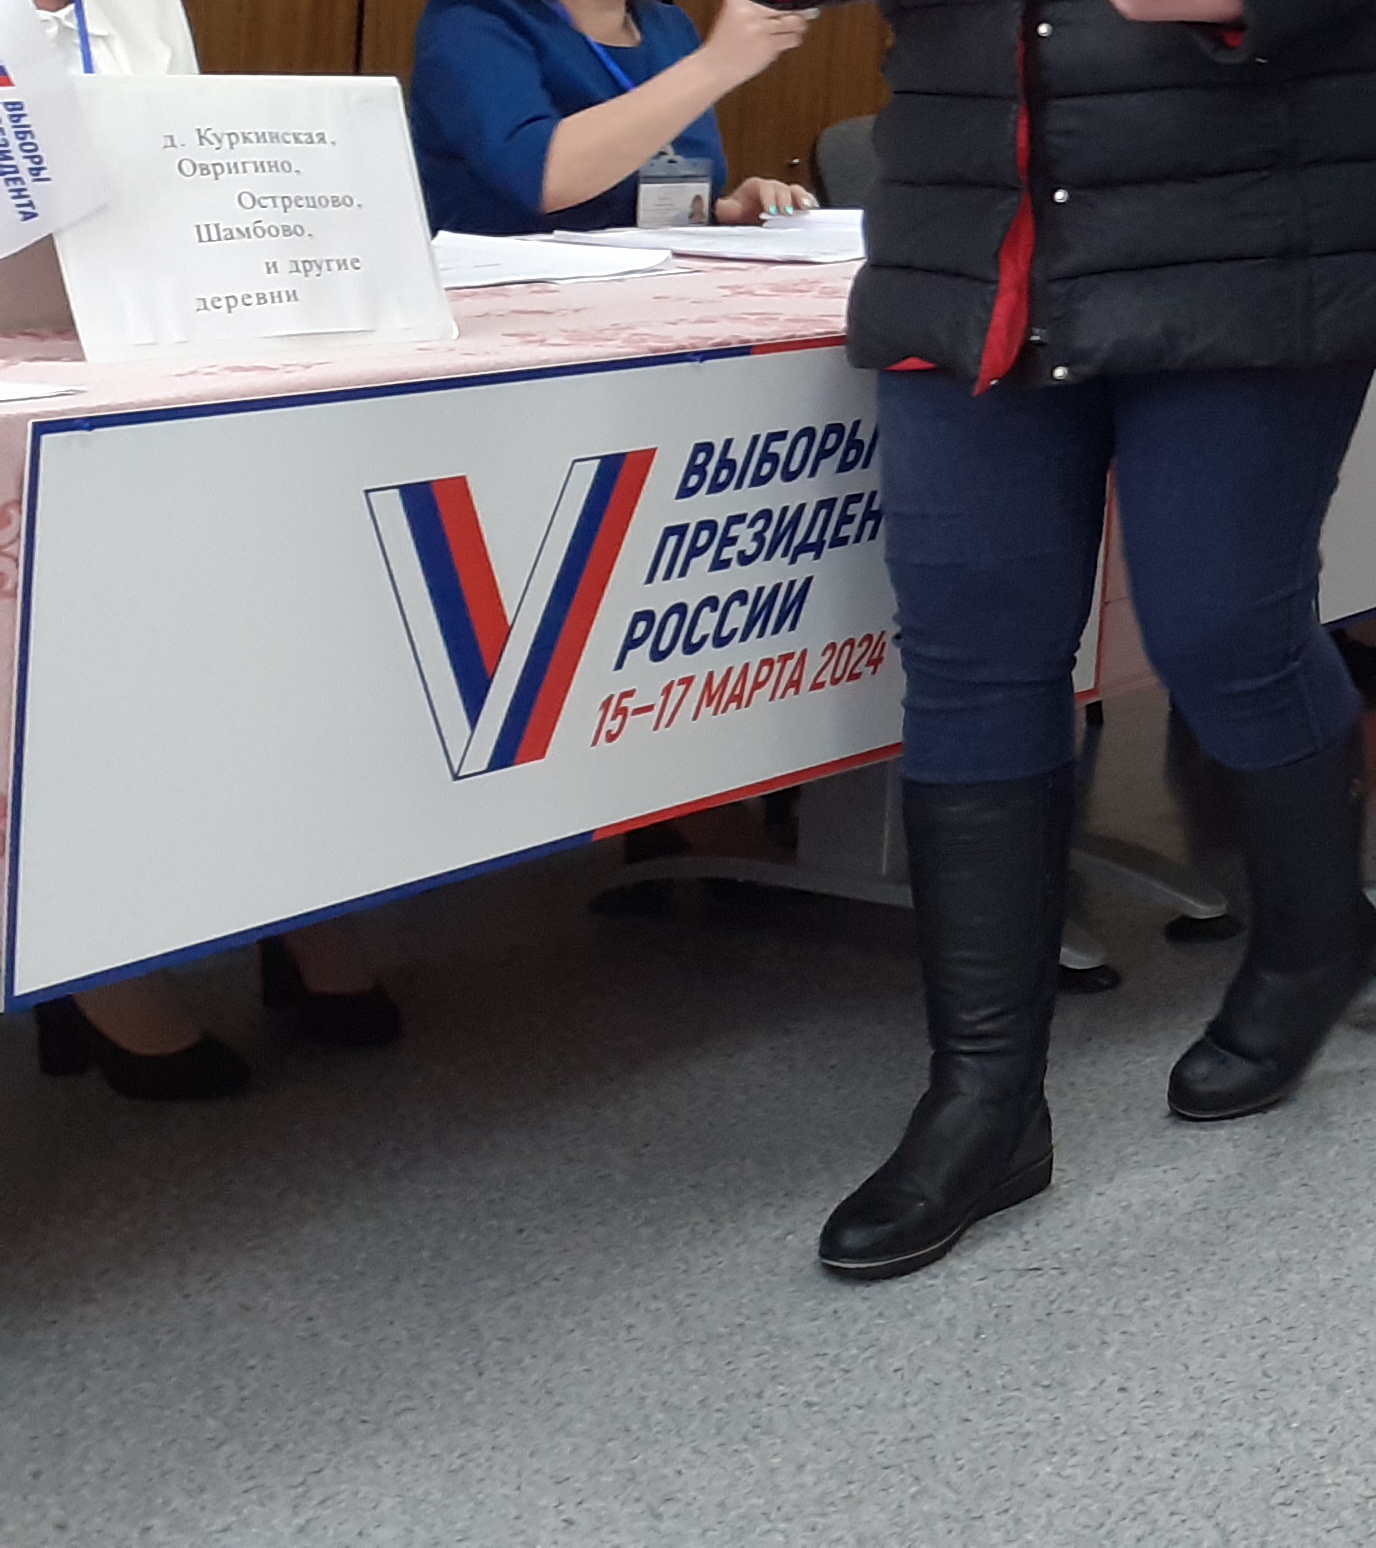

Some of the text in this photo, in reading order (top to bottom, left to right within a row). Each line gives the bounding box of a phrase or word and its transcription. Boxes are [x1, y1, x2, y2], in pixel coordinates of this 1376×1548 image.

[2, 100, 53, 183] ВЫБОРЫ
[163, 134, 186, 149] д.
[196, 288, 300, 313] деревни
[265, 257, 361, 277] и другие
[675, 419, 879, 500] ВЫБОРЫ
[643, 490, 884, 585] ПРЕЗИДЕН
[613, 575, 814, 671] РОССИИ
[692, 648, 808, 721] МАРТА
[808, 630, 886, 691] 2024
